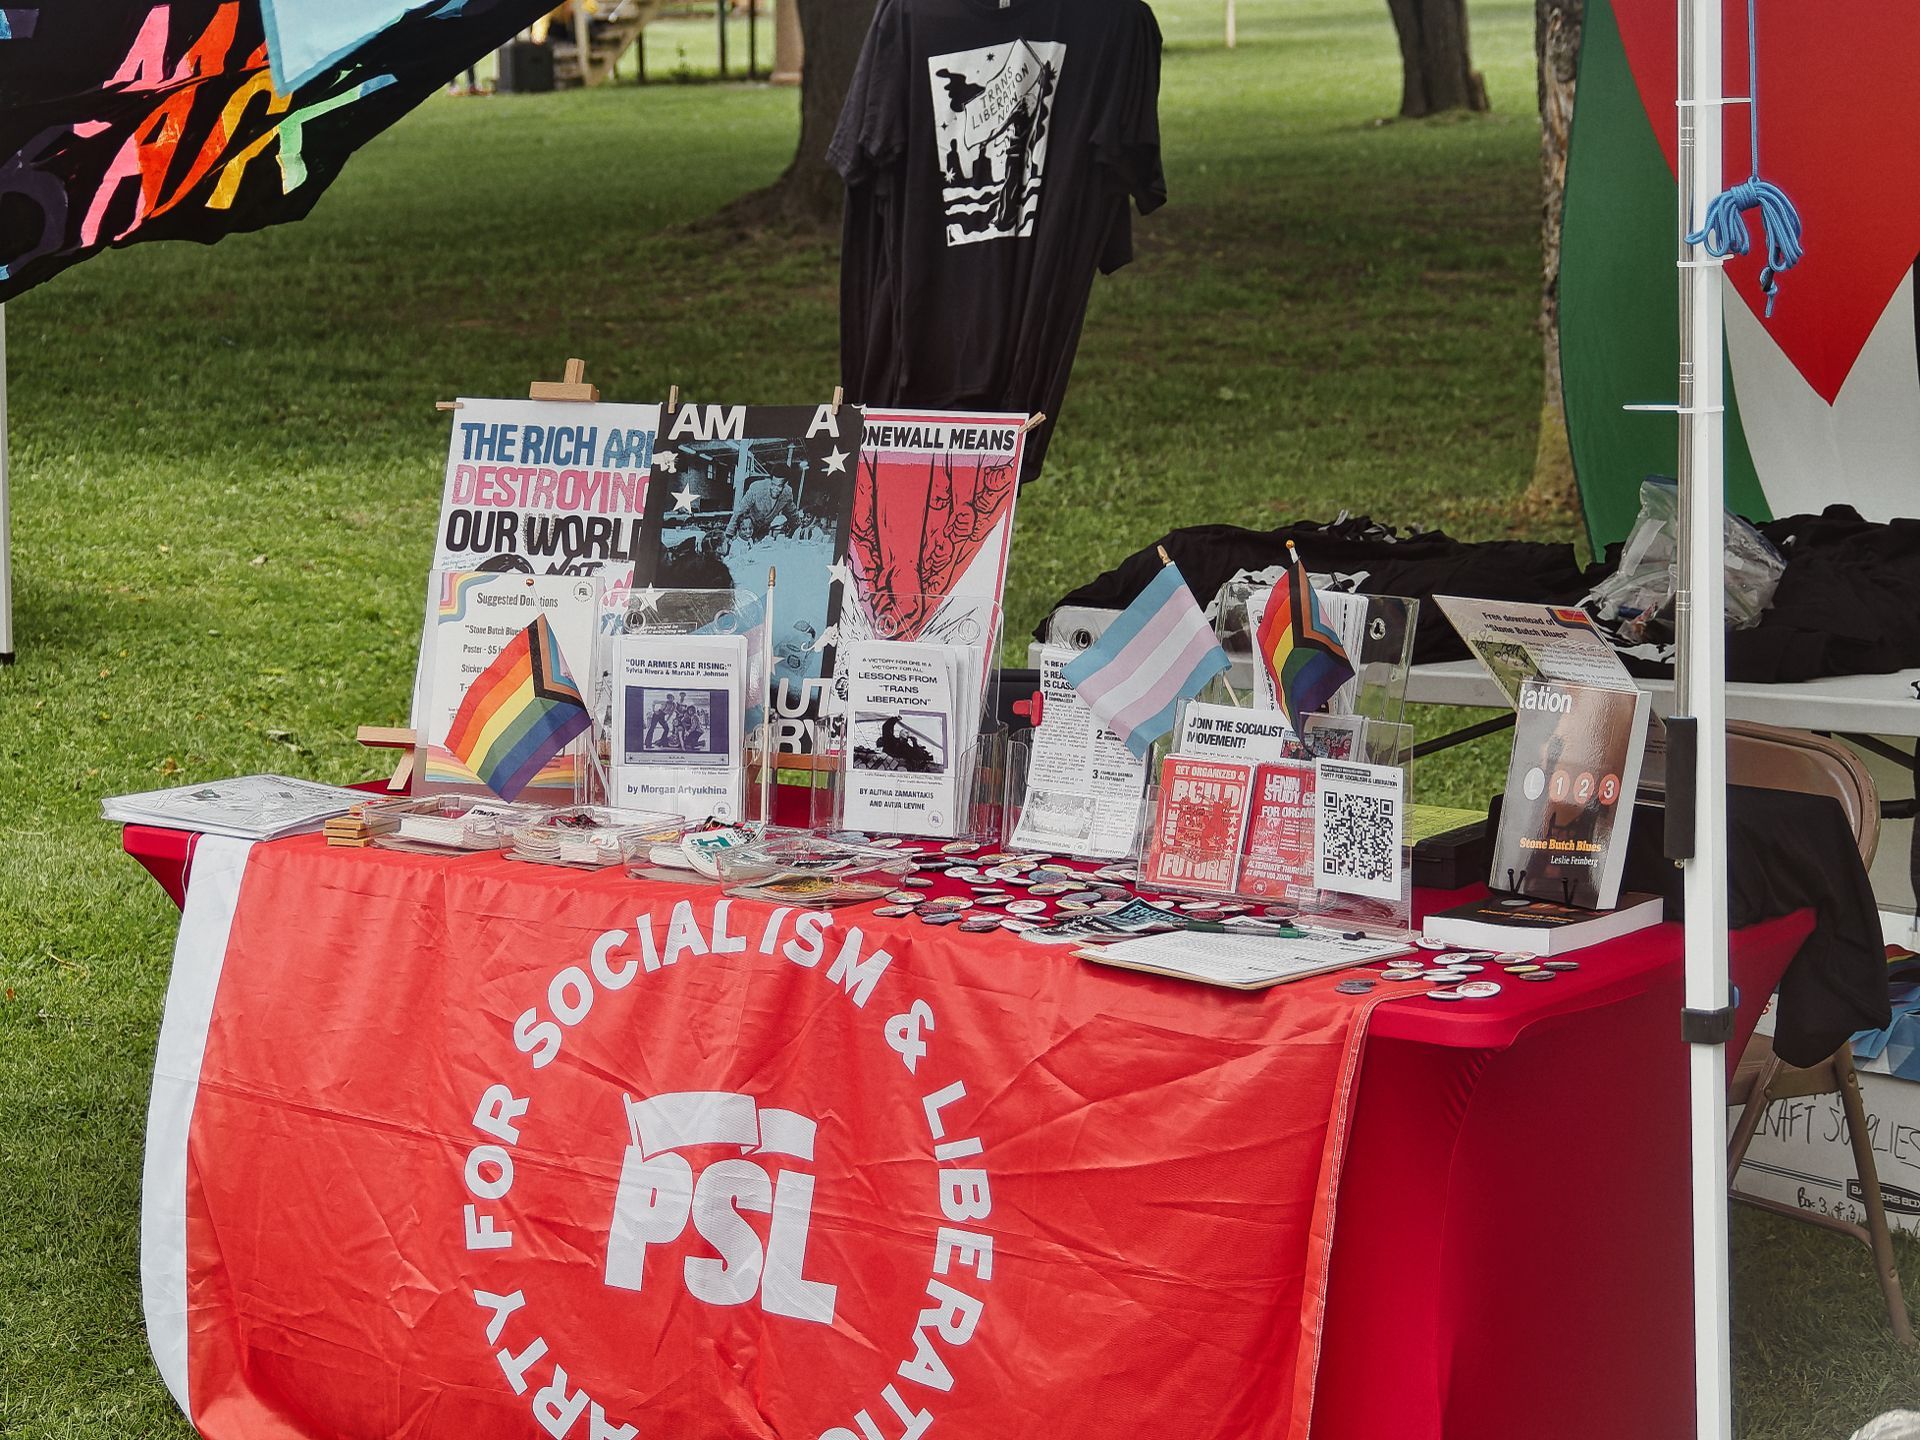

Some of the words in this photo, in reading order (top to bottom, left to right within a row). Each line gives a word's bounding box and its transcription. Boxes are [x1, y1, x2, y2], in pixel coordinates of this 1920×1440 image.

[980, 66, 1012, 109] TRANS
[972, 63, 1029, 129] LIBERATION
[668, 403, 746, 440] AM
[805, 404, 839, 438] A
[461, 423, 518, 461] THE
[521, 425, 598, 466] RICH
[949, 429, 1015, 450] MEANS
[446, 509, 518, 553] OUR
[477, 593, 518, 607] Suggested
[520, 594, 559, 608] Dontions
[1482, 612, 1501, 622] Free
[1503, 615, 1545, 625] download
[487, 625, 505, 635] Butch
[1515, 627, 1541, 637] Butch
[463, 644, 482, 654] Poster
[487, 644, 497, 655] $5
[461, 664, 483, 673] Sticker
[625, 658, 645, 667] "OUR
[647, 660, 678, 669] ARMIES
[680, 661, 696, 670] ARE
[625, 667, 643, 675] Sylvia
[645, 667, 664, 675] Rivera
[859, 672, 907, 682] LESSONS
[909, 675, 937, 684] FROM
[1043, 670, 1049, 678] 5
[880, 684, 919, 694] "TRANS
[1043, 680, 1051, 688] IS
[867, 695, 931, 706] LIBERATION"
[1044, 690, 1049, 701] 1
[1096, 729, 1103, 740] 2
[1189, 717, 1213, 731] JOIN
[1215, 719, 1233, 733] THE
[1235, 722, 1285, 738] SOCIALIST
[1187, 731, 1247, 749] MOVEMENT!
[1092, 769, 1099, 779] 3
[1175, 765, 1190, 775] GET
[1192, 766, 1237, 780] ORGANIZED
[1238, 771, 1246, 781] &
[1344, 774, 1368, 783] SOCIALISM
[627, 784, 638, 795] by
[641, 784, 676, 796] Morgan
[678, 785, 727, 795] Artyukhina
[860, 787, 869, 795] BY
[894, 789, 934, 800] ZAMANTAKIS
[1556, 777, 1563, 795] 1
[1578, 779, 1590, 798] 2
[1604, 780, 1614, 799] 3
[1264, 787, 1301, 805] STUDY
[870, 800, 881, 808] AND
[904, 802, 925, 811] LEVINE
[1262, 805, 1280, 818] FOR
[1519, 837, 1548, 850] Stone
[1548, 838, 1575, 852] Butch
[1576, 840, 1602, 853] Blues
[1162, 854, 1231, 881] FUTURE
[1550, 855, 1570, 865] Leslie
[1570, 856, 1599, 867] Feinberg
[513, 899, 892, 1069] SOCIALISM
[884, 998, 935, 1075] &
[464, 1083, 531, 1250] FOR
[1819, 1197, 1827, 1213] 3
[1848, 1204, 1856, 1220] 3
[604, 1144, 838, 1325] PSL
[818, 1080, 993, 1440] LIBERATI
